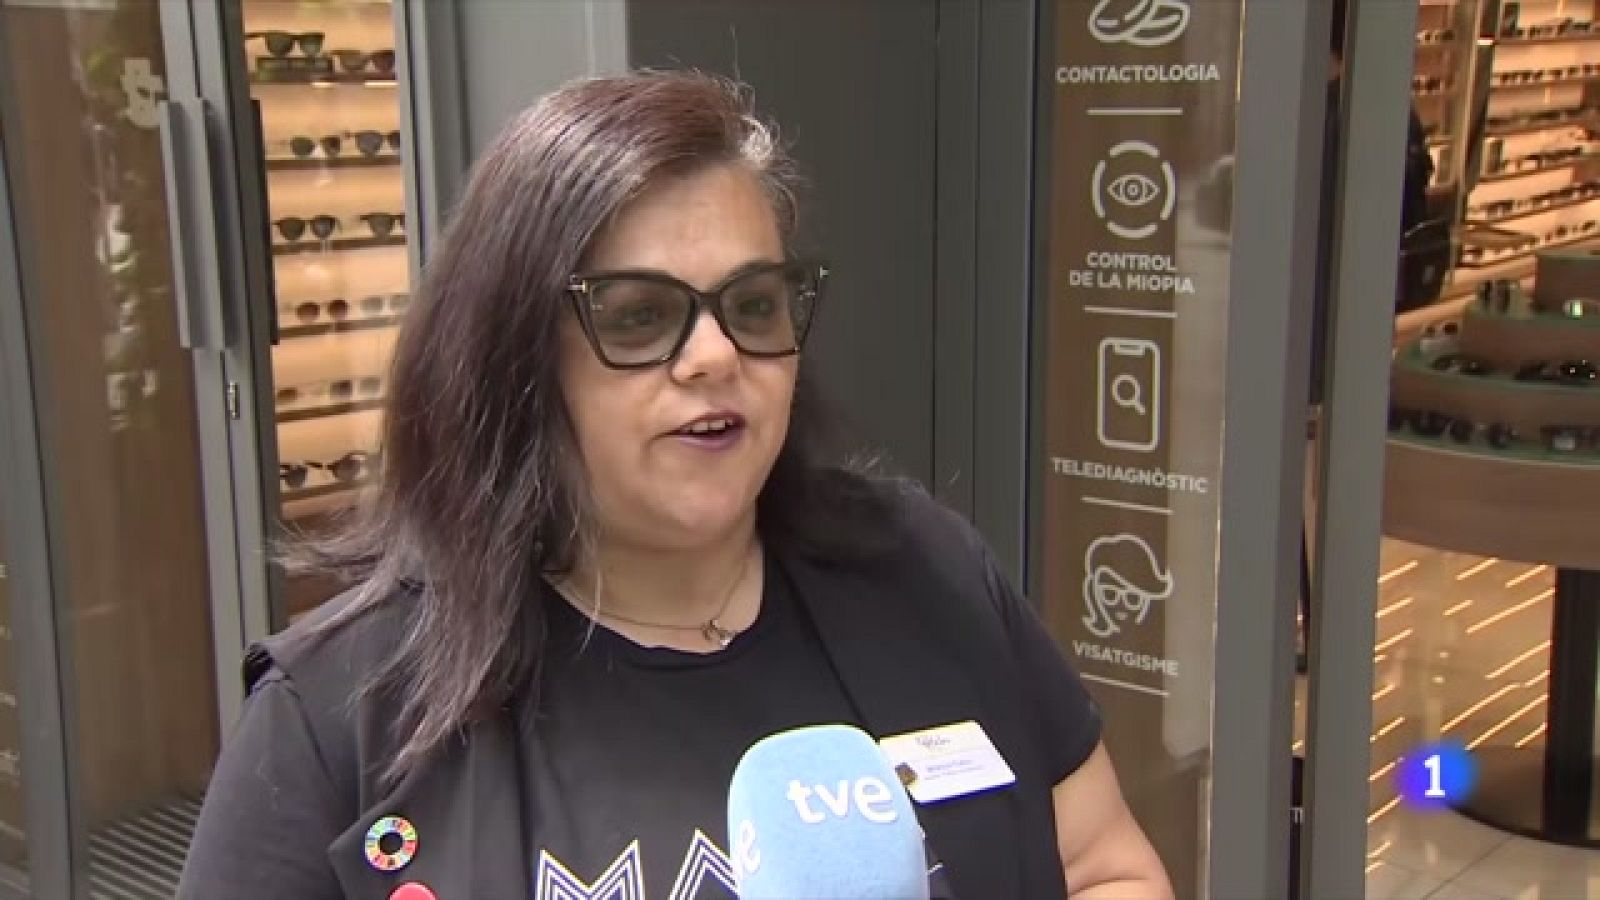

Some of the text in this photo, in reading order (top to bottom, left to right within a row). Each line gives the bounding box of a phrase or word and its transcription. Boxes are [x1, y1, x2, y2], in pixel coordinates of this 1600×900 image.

[1056, 64, 1220, 83] CONTACTOLOGIA
[1087, 252, 1177, 271] CONTROL
[1069, 270, 1195, 294] DE LA MIOPIA
[1072, 640, 1178, 676] VISATGISME
[786, 777, 898, 823] tve
